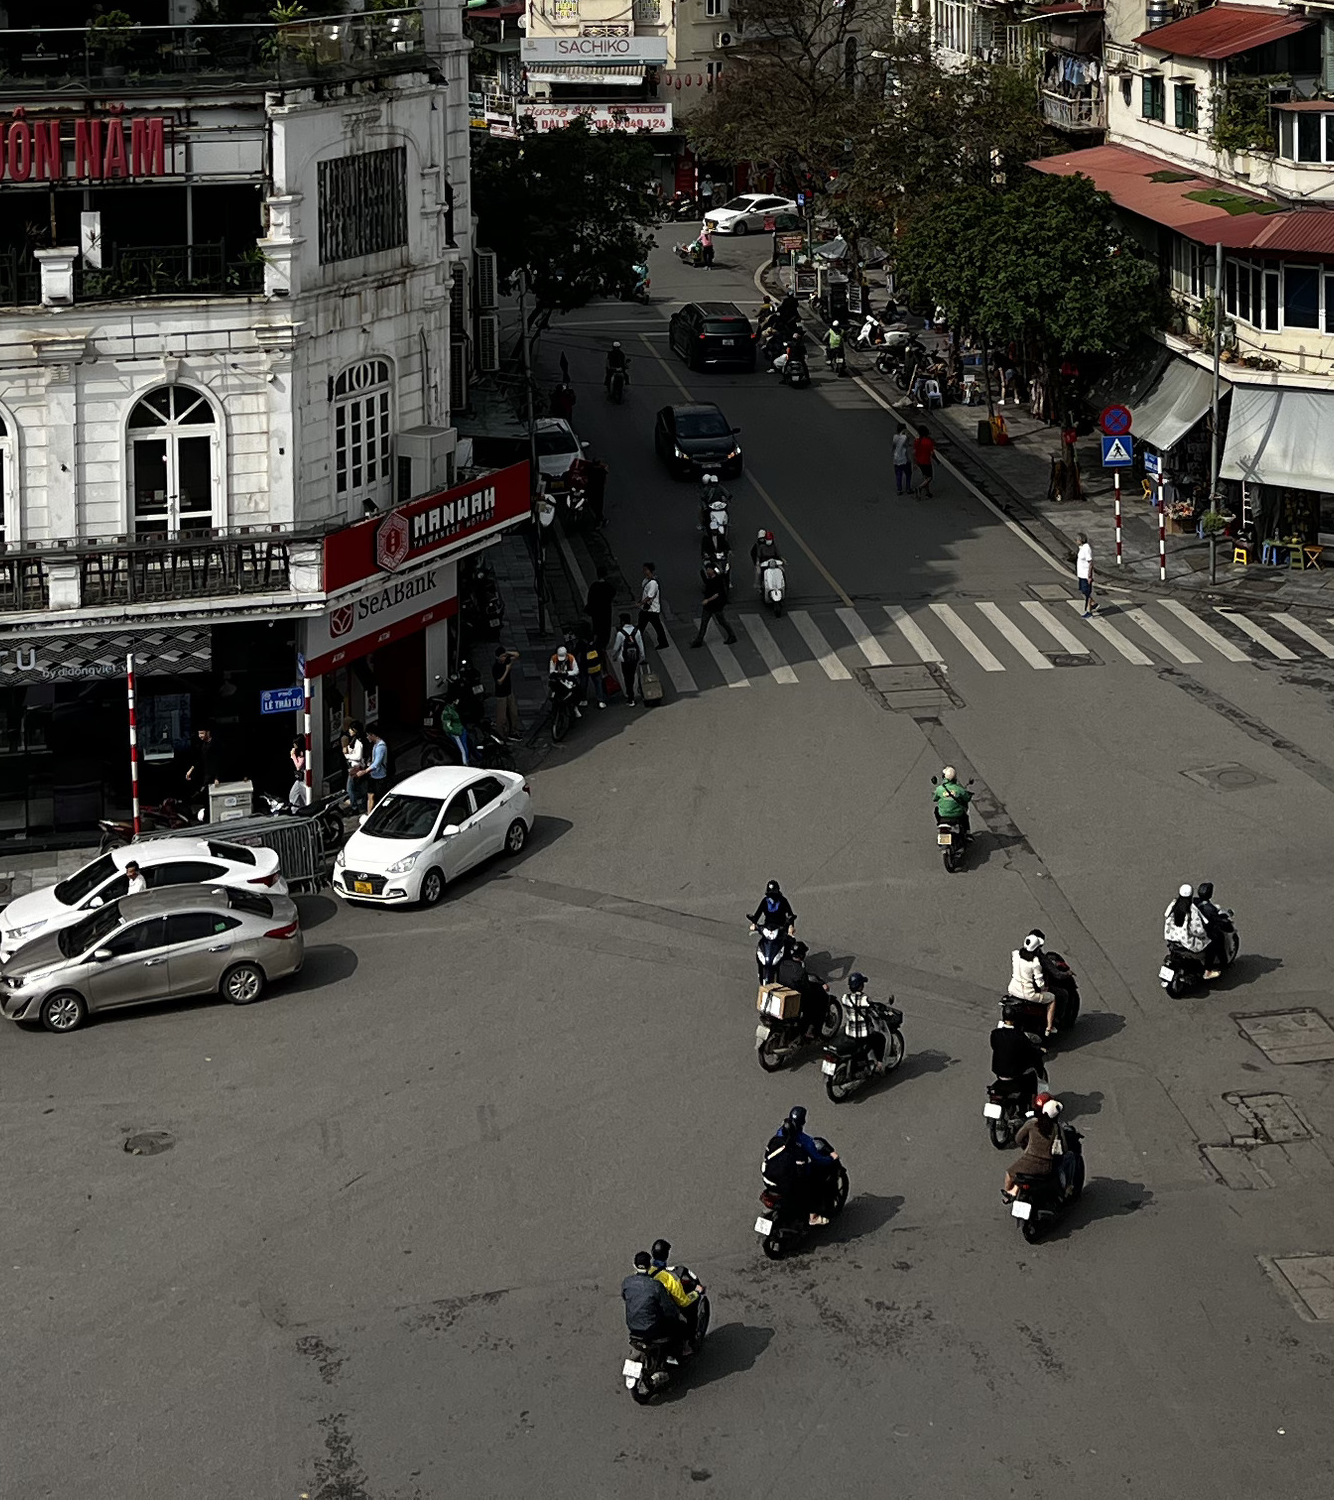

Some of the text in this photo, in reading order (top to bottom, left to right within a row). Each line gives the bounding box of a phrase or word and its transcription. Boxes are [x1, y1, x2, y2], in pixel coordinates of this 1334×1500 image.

[558, 40, 630, 54] SACHIKO
[75, 102, 165, 179] NĂM
[412, 486, 496, 539] MANWAH
[357, 570, 438, 621] SeABank
